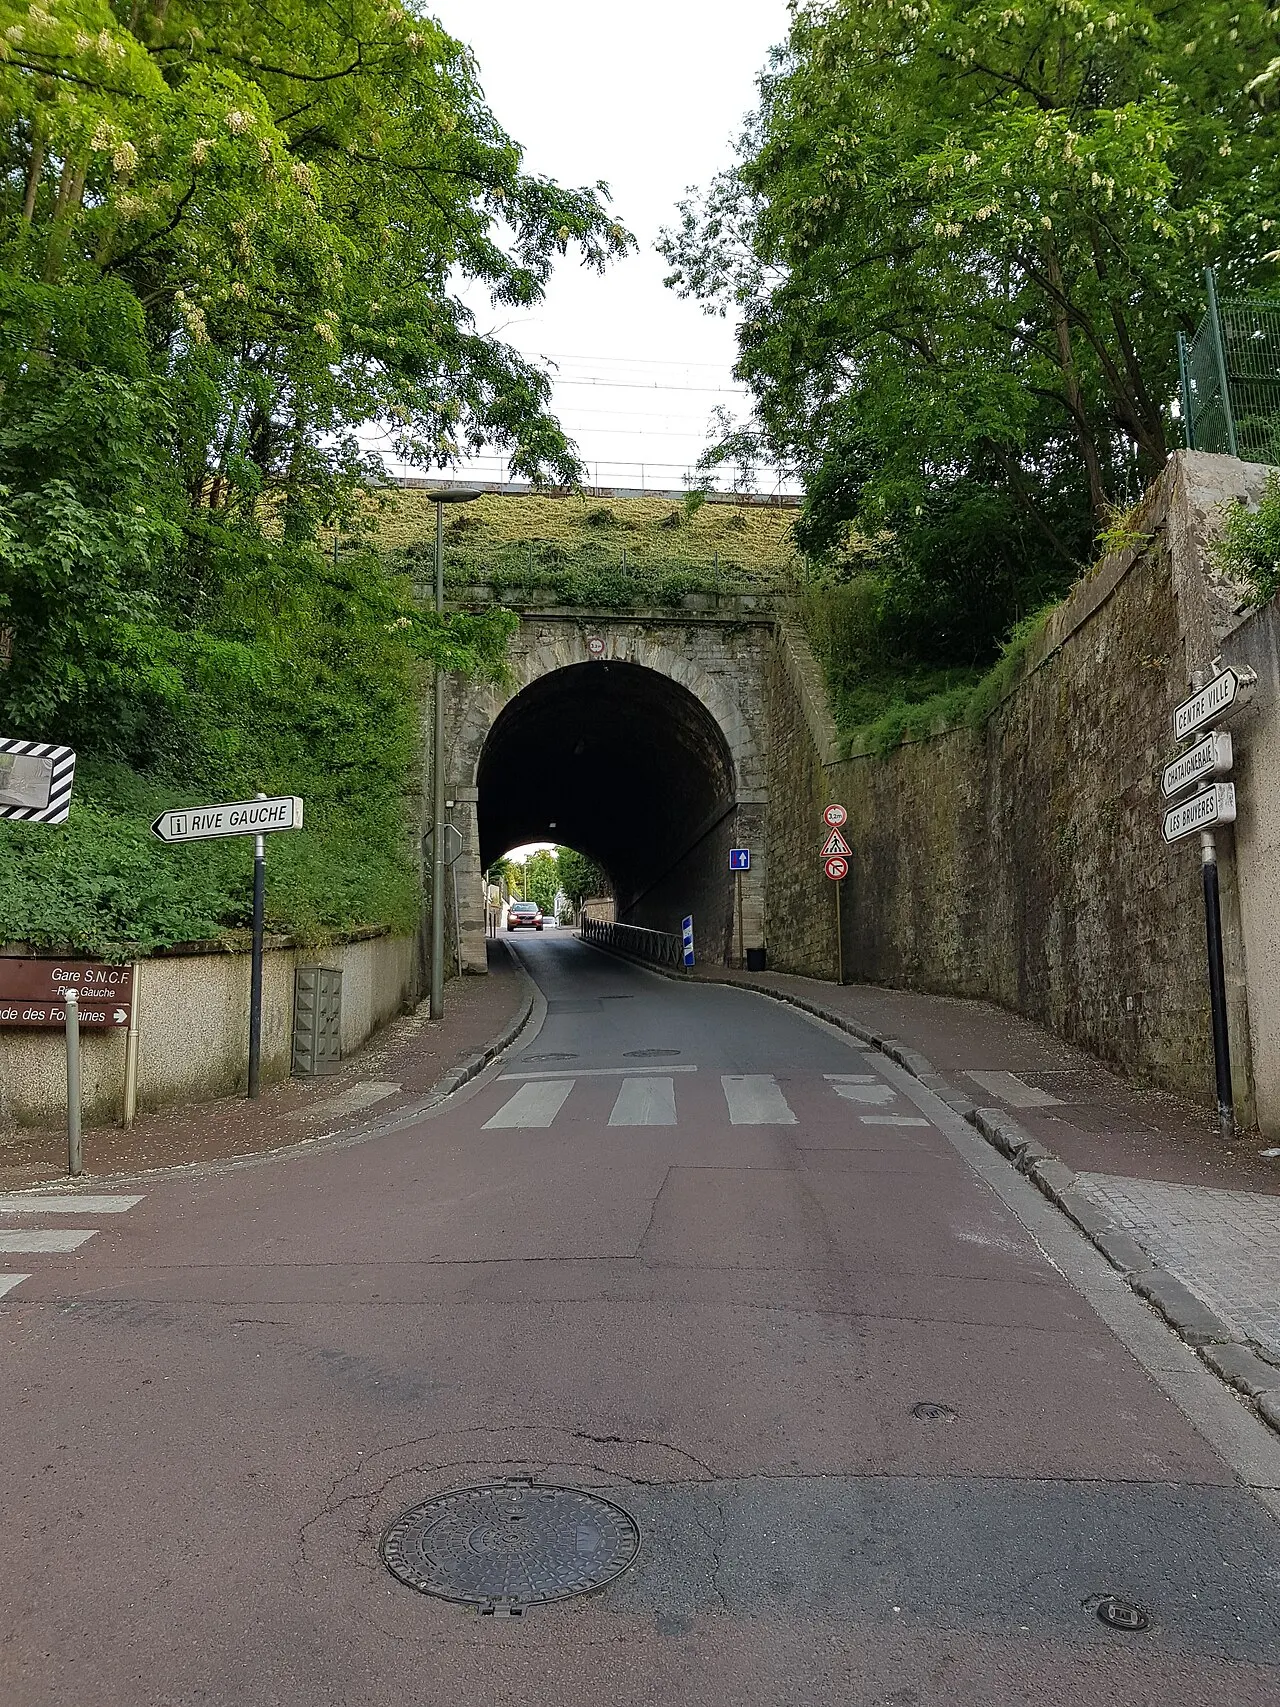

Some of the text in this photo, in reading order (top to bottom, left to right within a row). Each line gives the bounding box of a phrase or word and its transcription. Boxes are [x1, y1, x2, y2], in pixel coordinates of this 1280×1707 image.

[1178, 679, 1229, 730] CENTRE VILLE
[1167, 744, 1212, 788] CHATAIGNERAIE
[191, 813, 223, 831] RIVE
[229, 805, 287, 827] GAUCHE
[1170, 795, 1215, 833] LES BRUYÈRES
[51, 968, 81, 982] Gare
[80, 986, 115, 998] Gauche
[0, 1007, 106, 1022] de des Foaines
